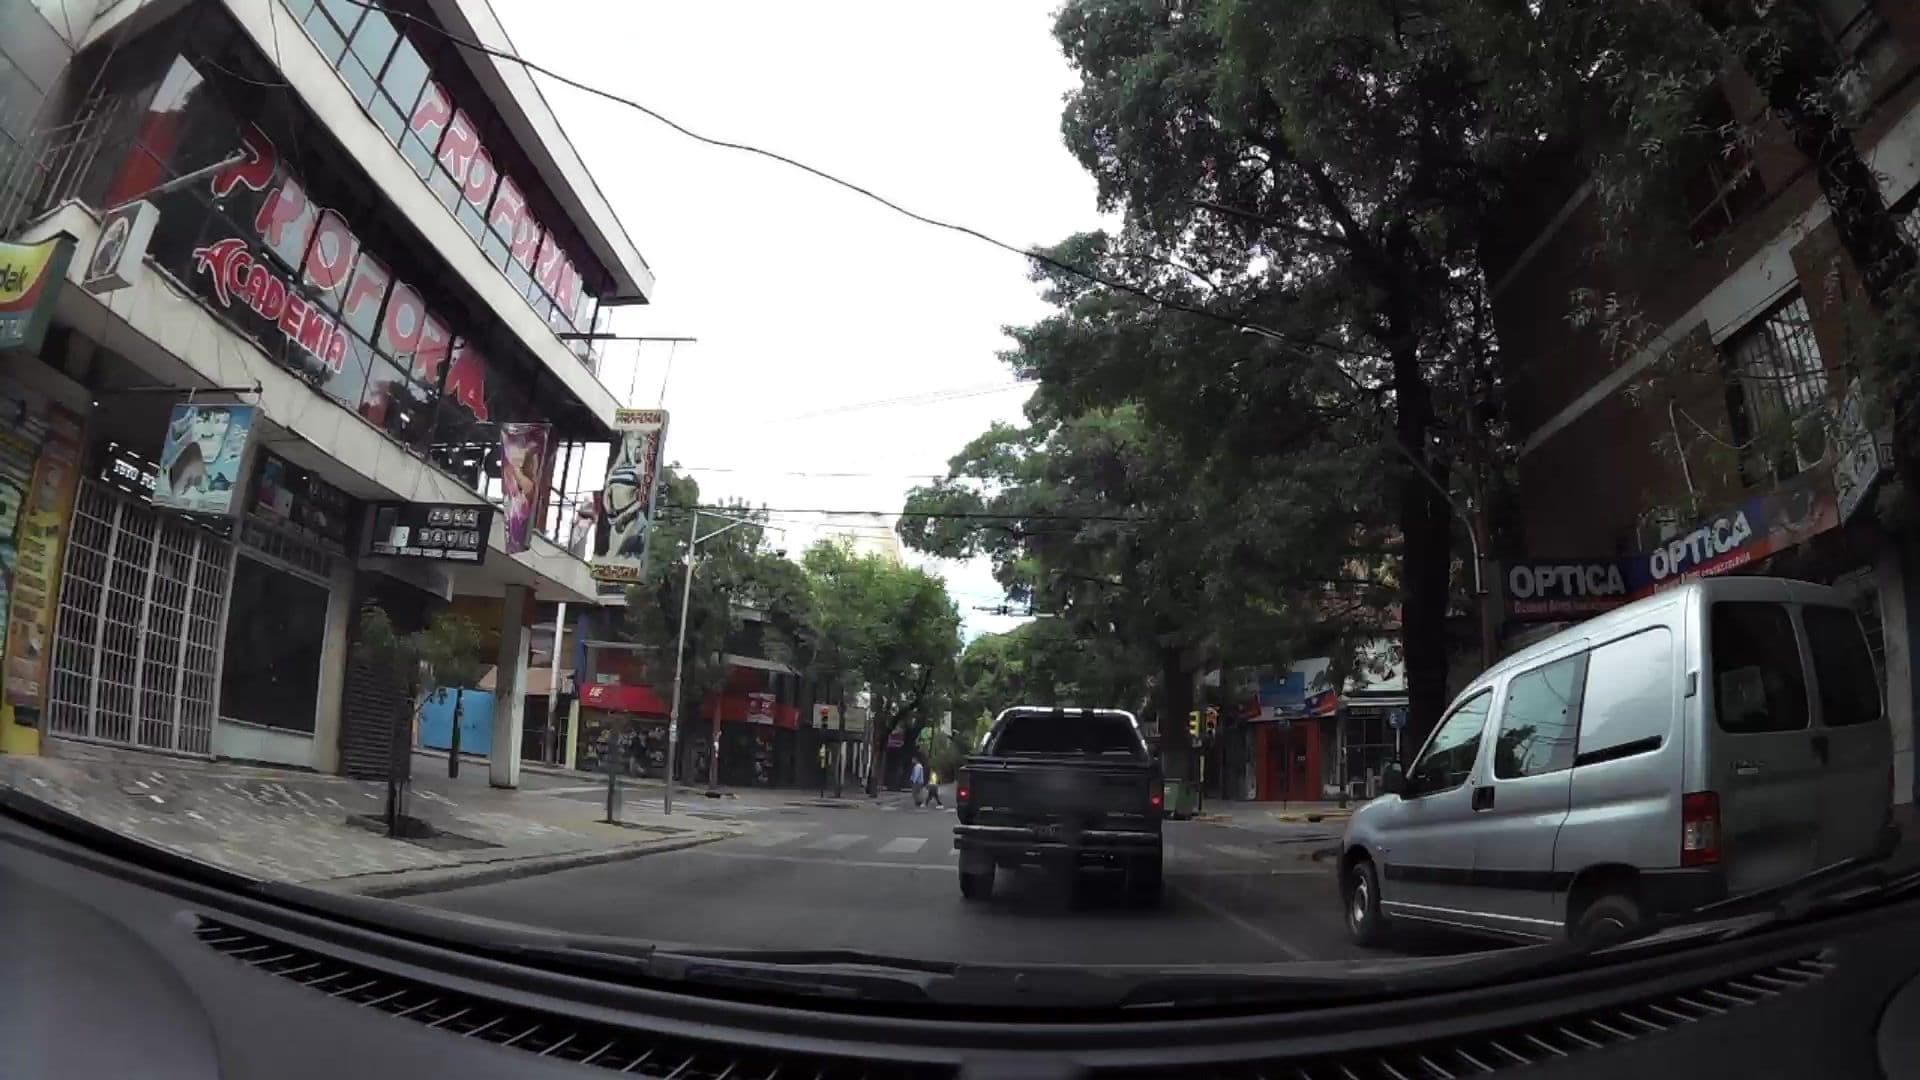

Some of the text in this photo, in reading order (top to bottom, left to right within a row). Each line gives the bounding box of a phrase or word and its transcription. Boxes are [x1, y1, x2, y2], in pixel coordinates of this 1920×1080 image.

[195, 238, 348, 374] ACADEMIA
[1651, 511, 1752, 580] OPTICA
[1509, 564, 1626, 598] OPTICA
